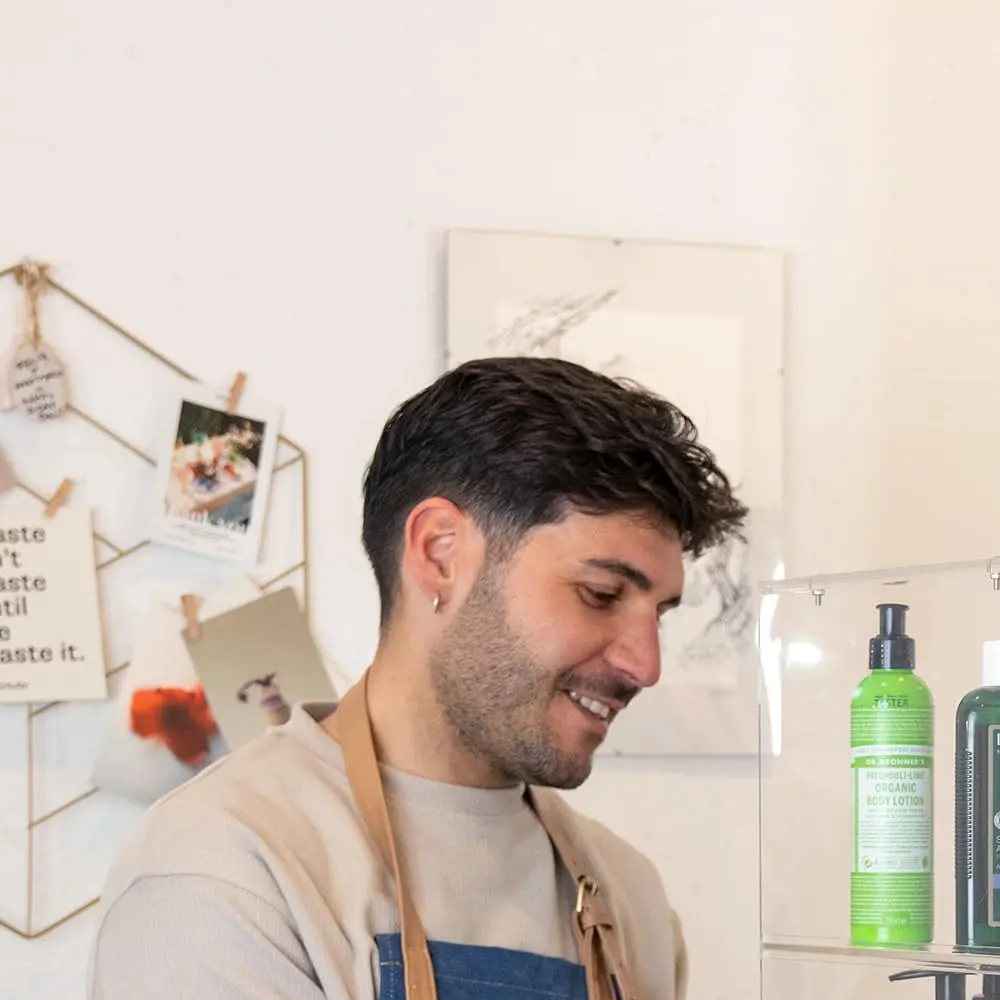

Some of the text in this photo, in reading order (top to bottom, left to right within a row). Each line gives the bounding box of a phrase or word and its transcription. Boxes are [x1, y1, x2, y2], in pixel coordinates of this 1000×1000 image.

[0, 549, 21, 568] 't
[0, 597, 28, 617] til
[0, 646, 53, 664] aste
[875, 783, 917, 793] ORGANIC
[867, 796, 925, 806] BODY LOTION
